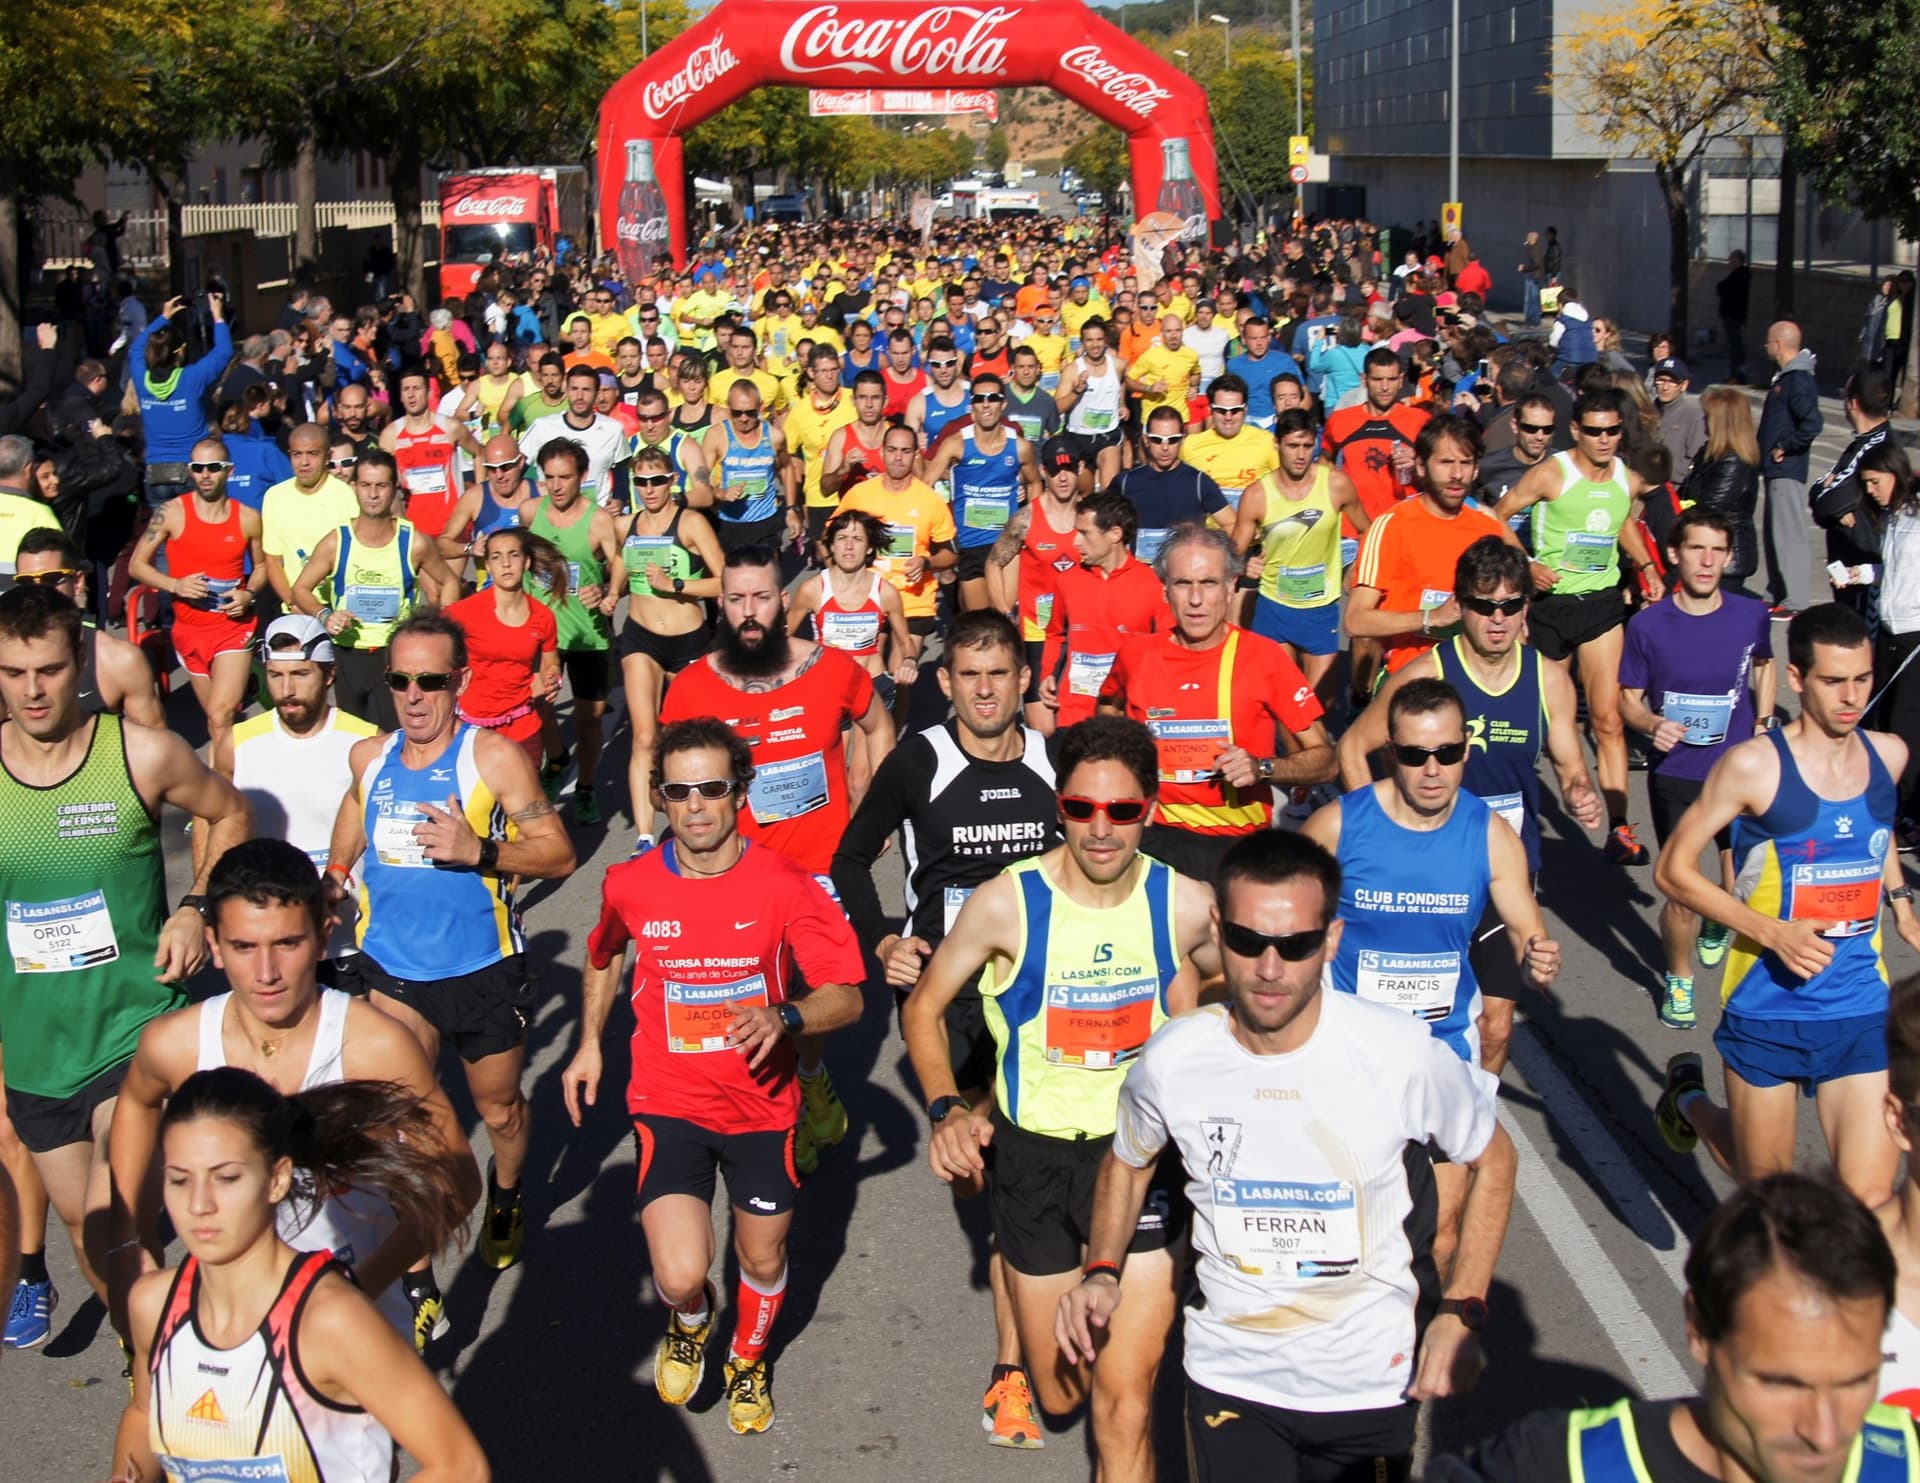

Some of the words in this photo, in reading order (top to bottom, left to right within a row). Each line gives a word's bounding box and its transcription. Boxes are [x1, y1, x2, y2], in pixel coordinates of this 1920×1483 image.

[780, 5, 1022, 75] Coca-Cola
[643, 33, 739, 119] Coca-Cola
[1060, 45, 1174, 118] Coca-Cola
[454, 195, 528, 217] Coca-Cola
[1683, 716, 1710, 730] 843
[1163, 743, 1209, 753] ANTONIO
[762, 778, 810, 795] CARMELO
[58, 802, 117, 816] CORREDORS
[59, 818, 72, 827] de
[74, 816, 101, 825] FONS
[103, 814, 118, 824] de
[952, 822, 1045, 843] RUNNERS
[953, 844, 993, 855] Sant
[1001, 841, 1044, 853] Adrià
[1354, 888, 1393, 904] CLUB
[1397, 892, 1470, 907] FONDISTES
[1818, 889, 1862, 904] JOSEP
[23, 895, 103, 918] LASANSI.COM
[1354, 902, 1378, 912] SANT
[1380, 904, 1406, 913] FELIU
[1407, 905, 1419, 913] DE
[1421, 906, 1468, 914] LLOBREGAT
[33, 924, 82, 940] ORIOL
[641, 920, 682, 938] 4083
[48, 939, 72, 949] 5122
[664, 957, 702, 968] CURSA
[703, 956, 760, 968] BOMBERS
[1382, 958, 1458, 969] LASANSI.COM
[668, 970, 686, 979] Deu
[687, 970, 708, 981] anys
[709, 970, 721, 979] de
[722, 969, 749, 979] Cursa
[1061, 966, 1142, 980] LASANSI.COM
[685, 980, 763, 999] LASANSI.COM
[1377, 979, 1440, 991] FRANCIS
[1072, 984, 1155, 1003] LASANSI.COM
[1242, 1184, 1351, 1204] LASANSI.COM
[1243, 1216, 1327, 1234] FERRAN
[1272, 1237, 1301, 1249] 5007
